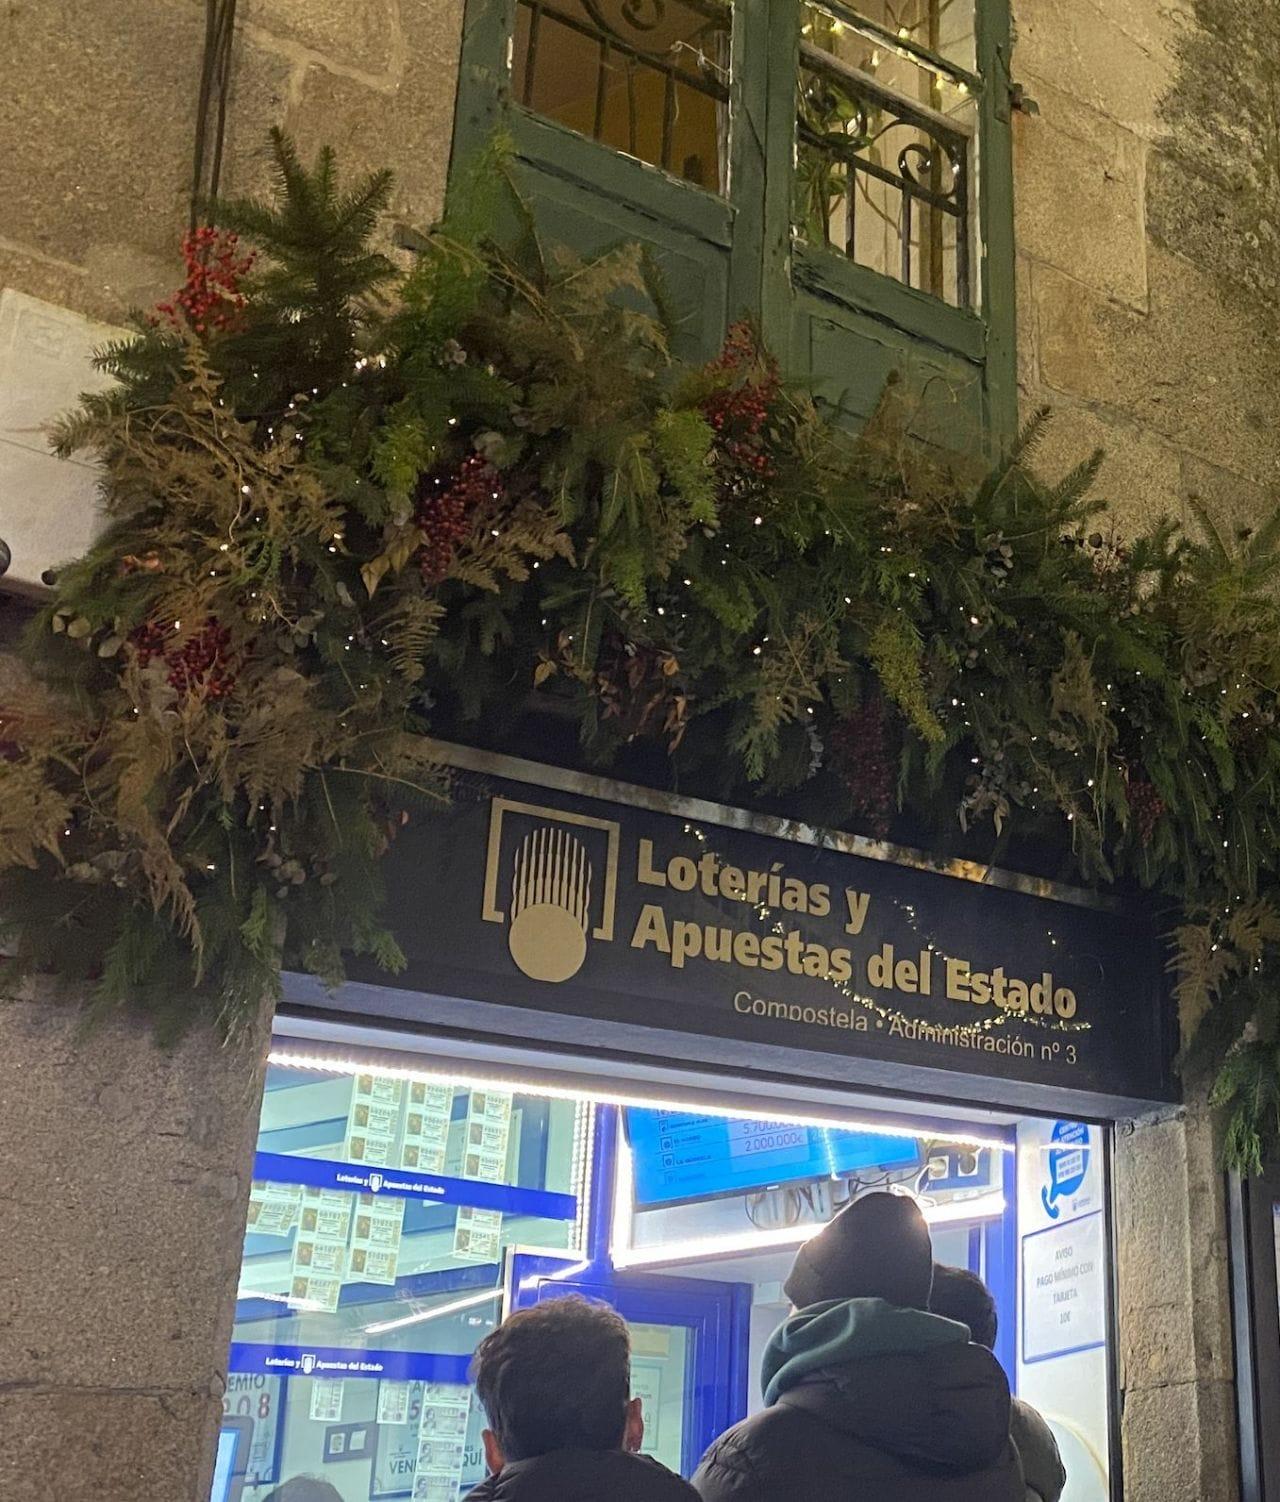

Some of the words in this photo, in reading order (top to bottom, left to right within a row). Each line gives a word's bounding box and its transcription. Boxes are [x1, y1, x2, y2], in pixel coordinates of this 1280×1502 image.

[637, 838, 831, 917] Loterías
[845, 887, 871, 935] y
[630, 904, 852, 981] Apuestas
[867, 943, 931, 996] del
[946, 959, 1077, 1019] Estado
[734, 991, 868, 1031] Compostela
[888, 1014, 1035, 1059] Administración
[1066, 1044, 1077, 1065] 3
[227, 1373, 266, 1392] EMIO
